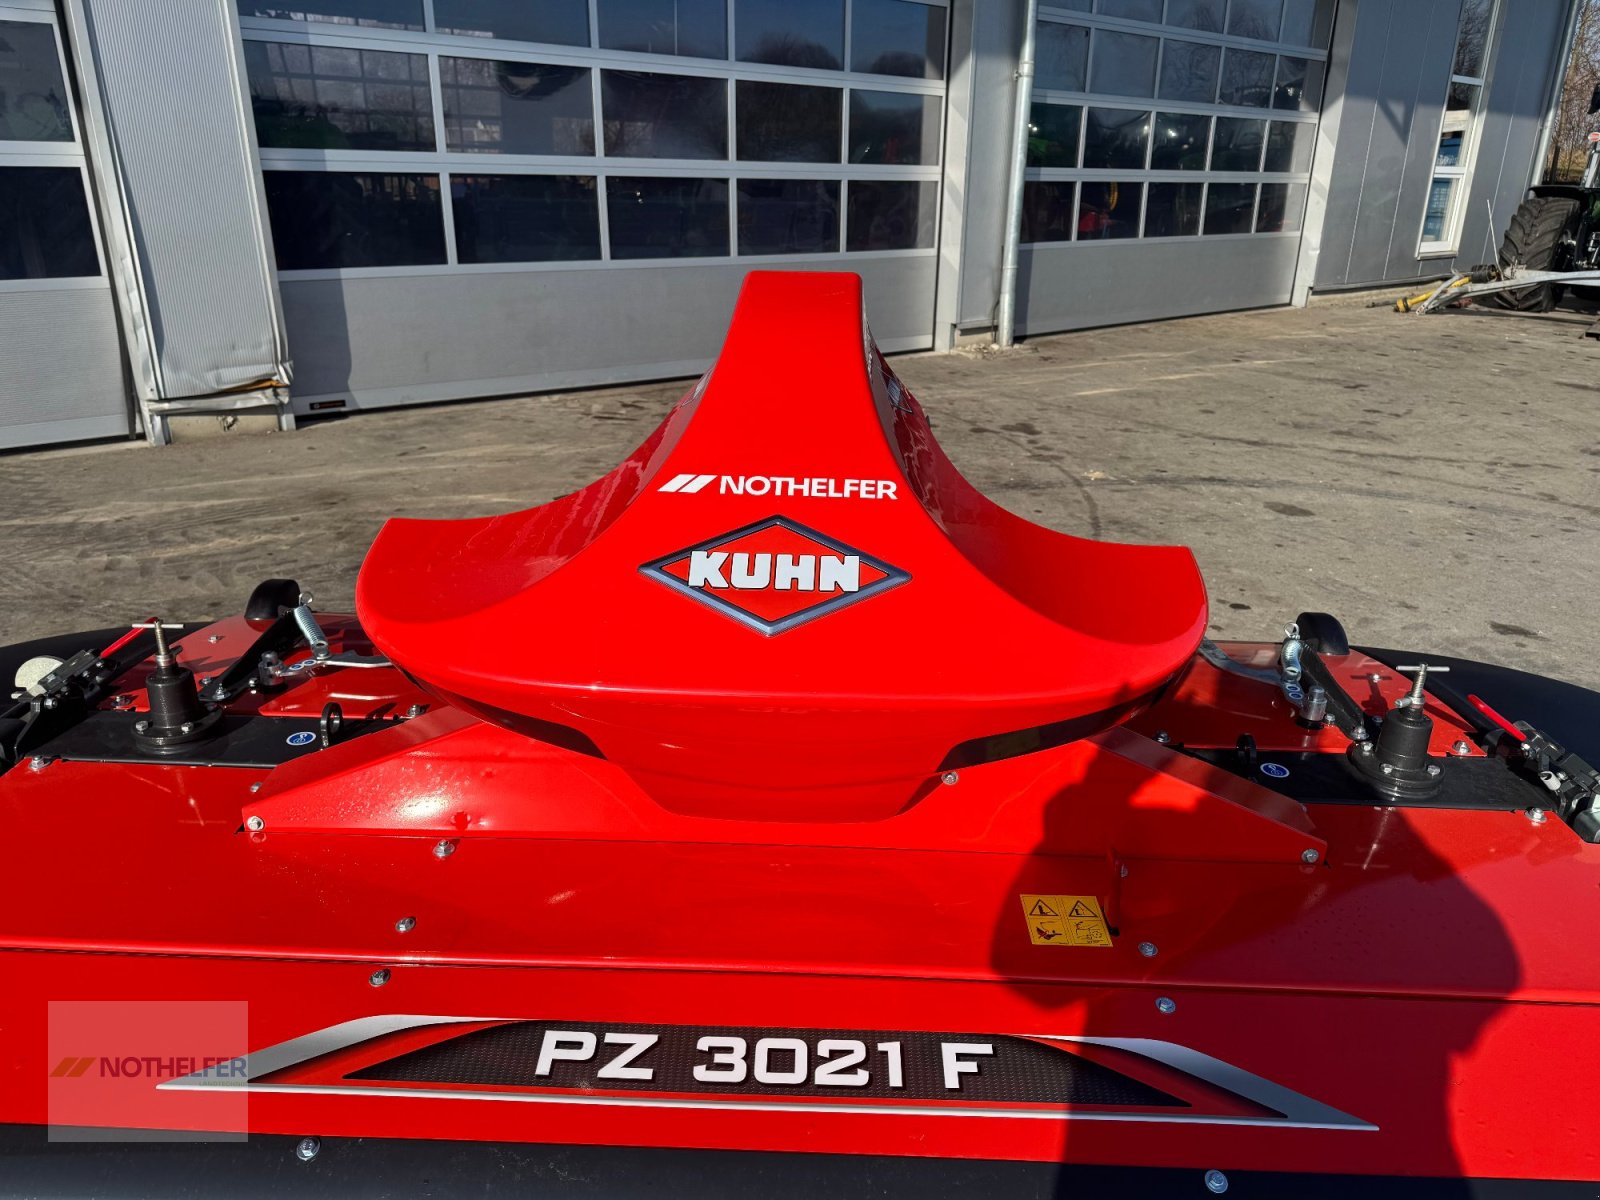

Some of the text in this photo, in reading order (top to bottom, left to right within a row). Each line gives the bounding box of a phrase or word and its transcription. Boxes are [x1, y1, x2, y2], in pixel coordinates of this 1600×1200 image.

[719, 475, 898, 500] NOTHELFER
[688, 550, 860, 593] KUHN
[535, 1030, 994, 1089] PZ 3021 F
